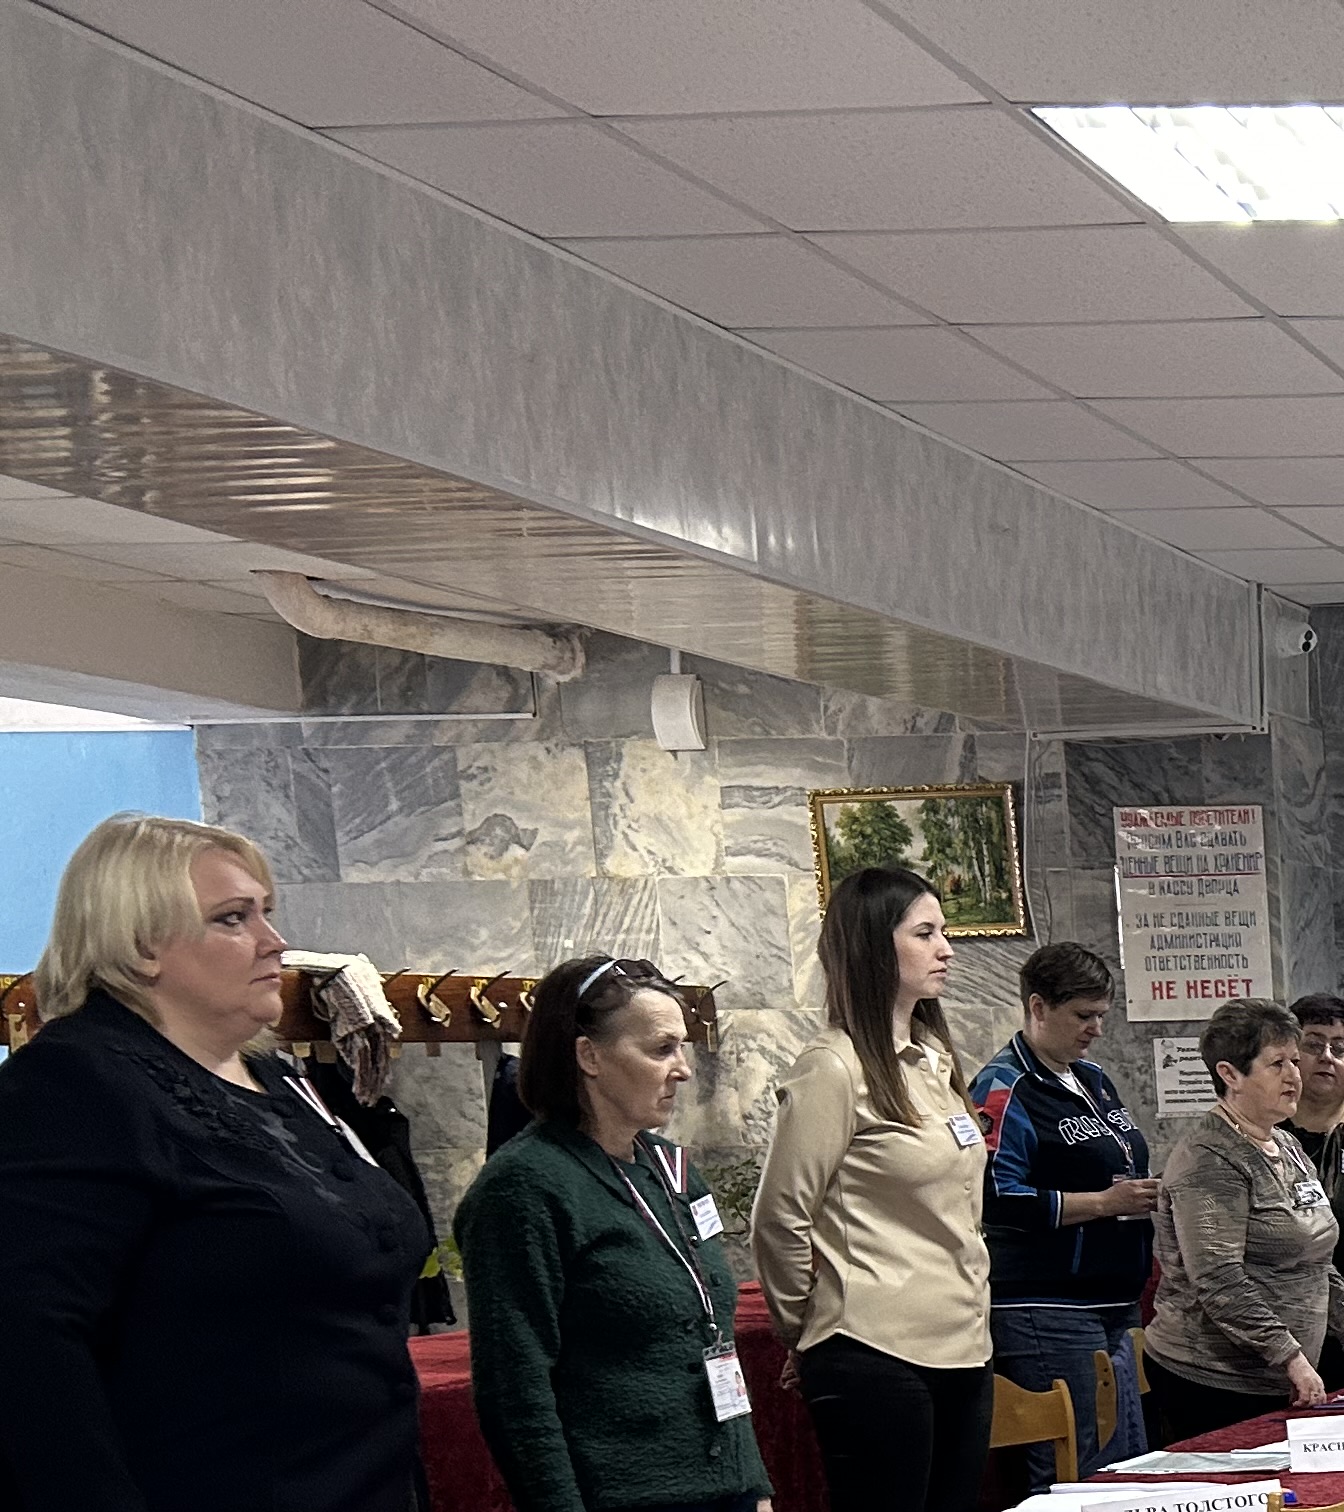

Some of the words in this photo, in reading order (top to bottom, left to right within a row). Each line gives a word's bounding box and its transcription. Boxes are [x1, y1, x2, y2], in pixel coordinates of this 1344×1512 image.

[1160, 880, 1193, 895] КАССУ
[1136, 912, 1149, 928] ЗА
[1153, 912, 1166, 928] НЕ
[1145, 954, 1249, 971] ОТВЕТСТВЕННОСТЬ
[1151, 980, 1177, 1000] НЕ
[1186, 974, 1252, 999] НЕСЁТ
